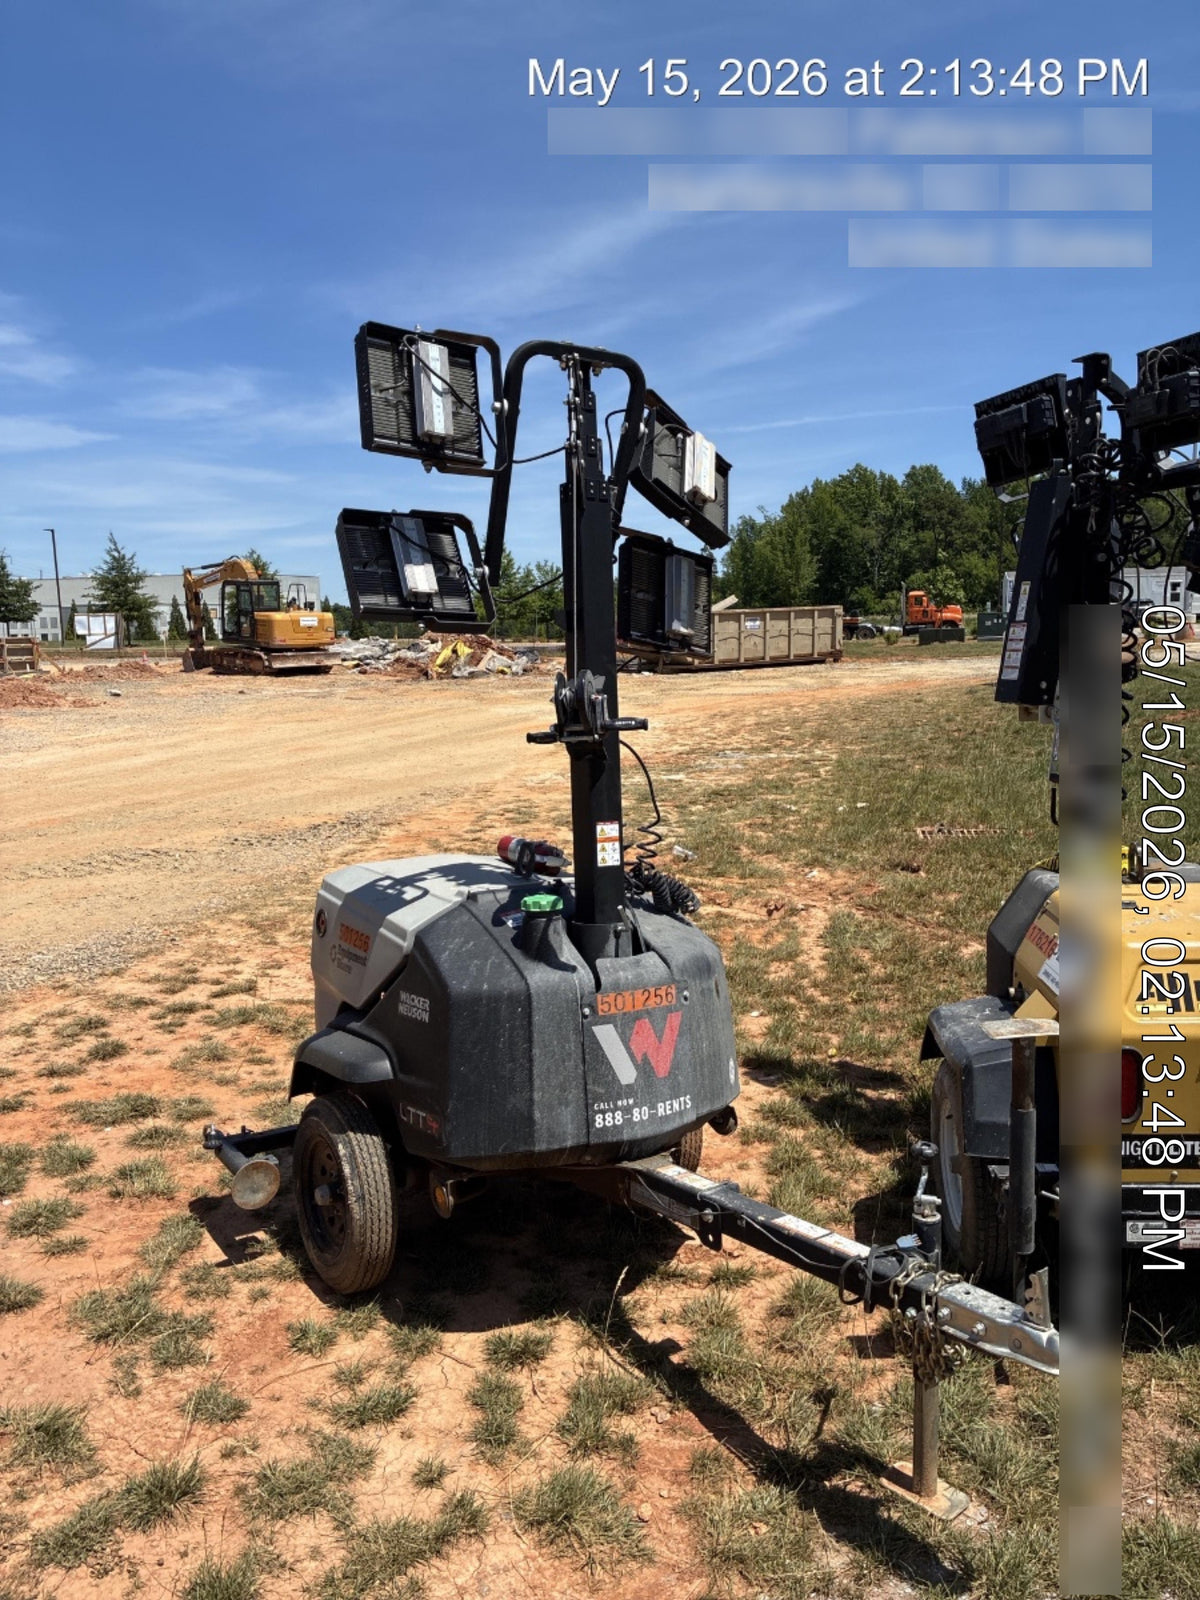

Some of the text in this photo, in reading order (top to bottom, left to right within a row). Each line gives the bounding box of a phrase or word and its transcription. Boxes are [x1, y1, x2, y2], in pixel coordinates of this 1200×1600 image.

[399, 990, 430, 1011] WACKER
[599, 985, 675, 1014] 501256
[1136, 973, 1200, 1012] All
[398, 1003, 429, 1023] NEUSON
[593, 1097, 635, 1111] CALL NOW
[595, 1095, 692, 1128] 888-80-RENTS
